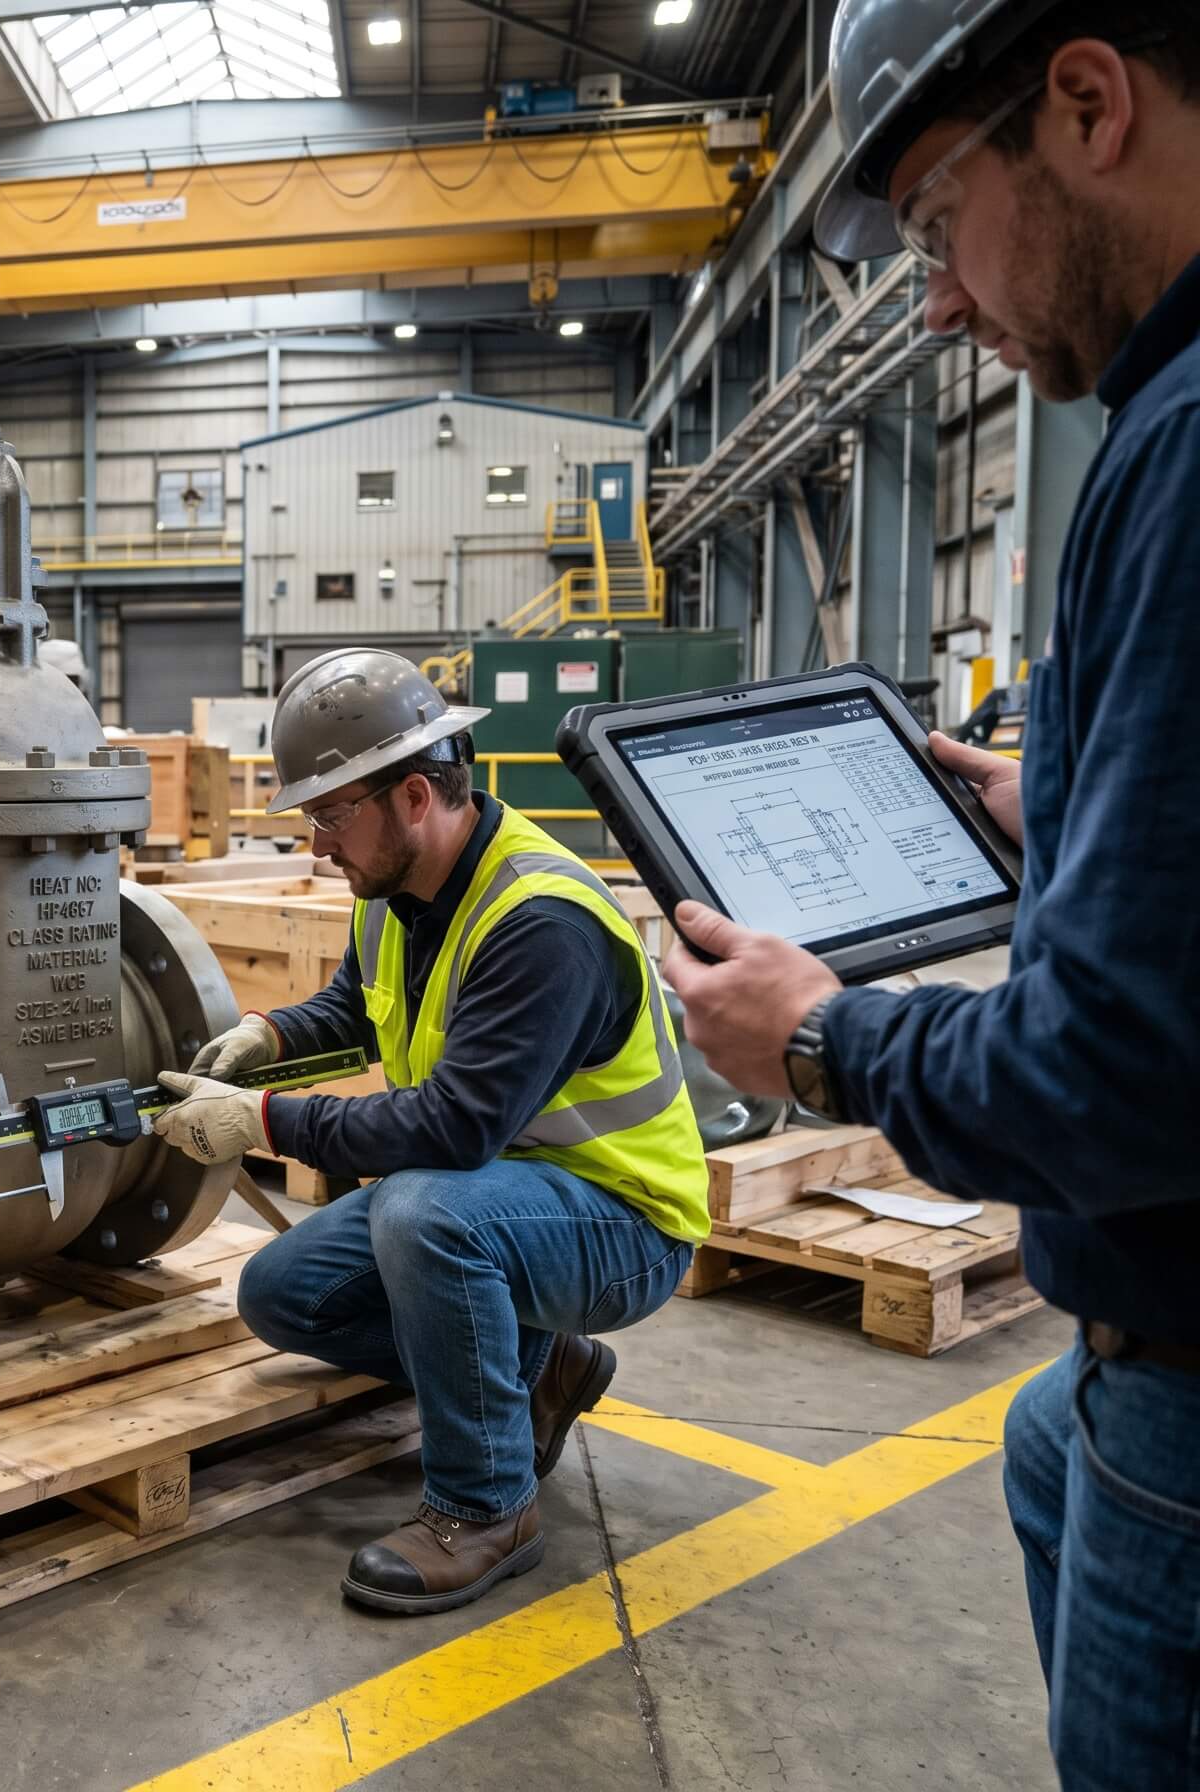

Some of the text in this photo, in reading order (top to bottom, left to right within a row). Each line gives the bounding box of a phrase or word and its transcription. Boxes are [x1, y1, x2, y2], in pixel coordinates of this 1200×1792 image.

[30, 875, 101, 896] HEAT NO:
[7, 927, 64, 947] CLASS
[27, 948, 107, 970] MATERIAL:
[17, 1024, 67, 1047] ASME
